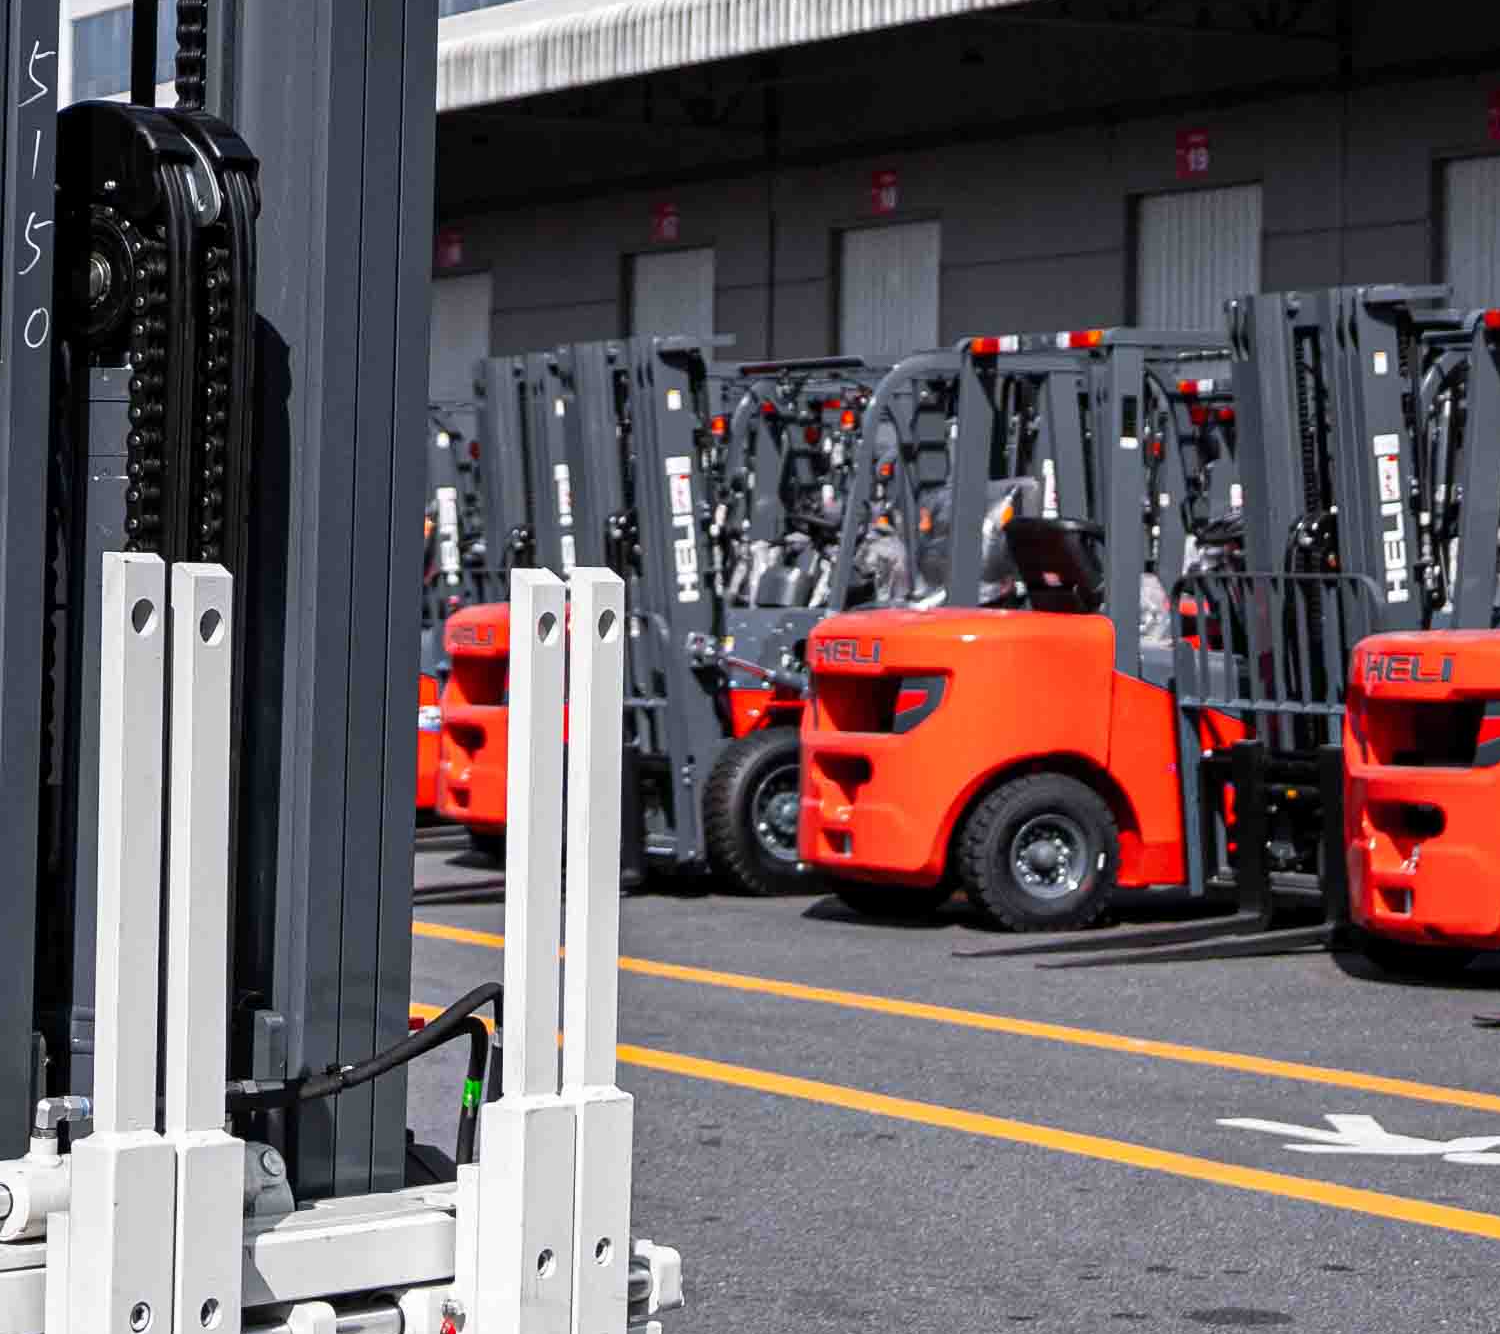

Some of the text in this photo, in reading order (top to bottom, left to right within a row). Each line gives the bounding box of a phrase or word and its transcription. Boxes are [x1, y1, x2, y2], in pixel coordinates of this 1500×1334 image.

[671, 514, 700, 603] HELI
[1381, 501, 1409, 604] HELI
[814, 636, 882, 665] HELI
[1363, 652, 1454, 684] HELI
